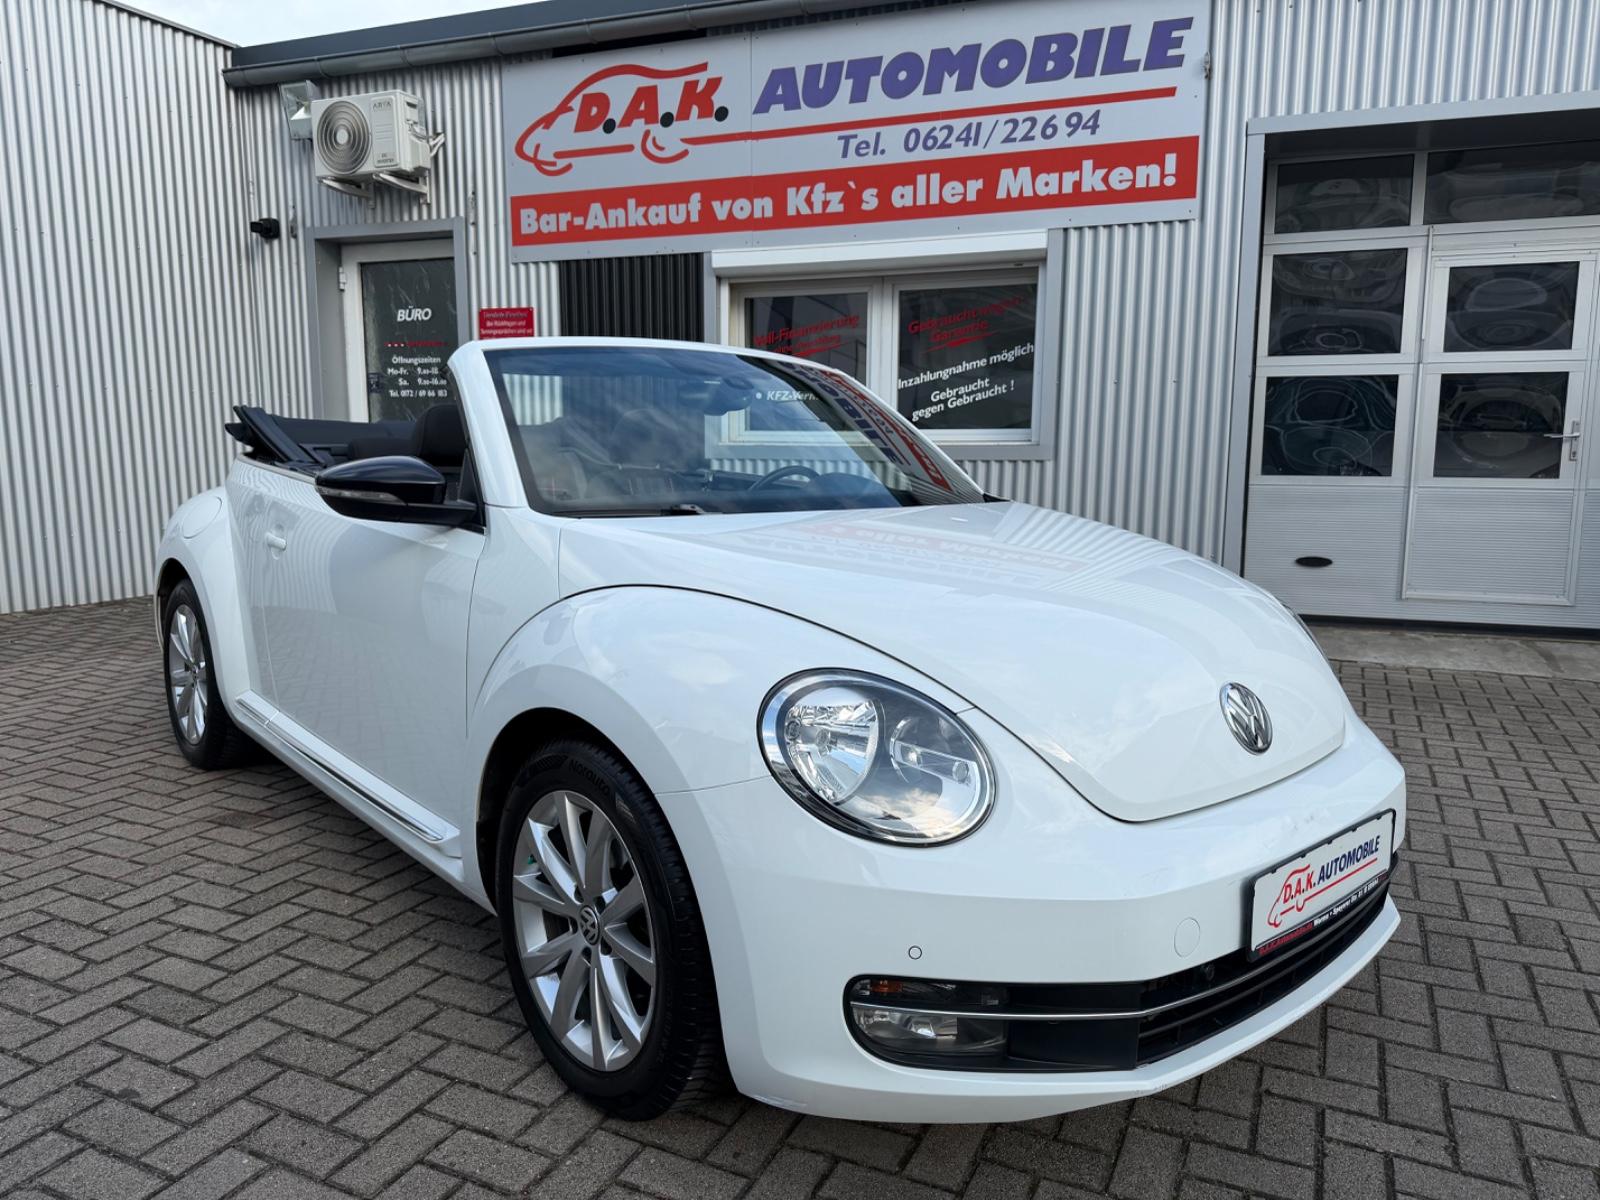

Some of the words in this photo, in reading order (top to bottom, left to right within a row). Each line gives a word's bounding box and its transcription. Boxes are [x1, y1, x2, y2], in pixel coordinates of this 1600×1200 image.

[573, 76, 728, 134] D.A.K.
[752, 16, 1194, 115] AUTOMOBILE
[837, 131, 887, 159] Tel.
[519, 191, 702, 235] Bar-Ankauf
[711, 195, 774, 222] von
[891, 172, 984, 209] aller
[995, 152, 1177, 200] Marken!
[396, 305, 433, 322] BÜRO
[897, 357, 988, 389] Inzahlungnahme
[989, 342, 1035, 365] möglich
[912, 403, 945, 422] gegen
[947, 383, 1008, 408] Gebraucht
[930, 377, 990, 402] Gebraucht
[1317, 835, 1381, 885] AUTOMOBILE
